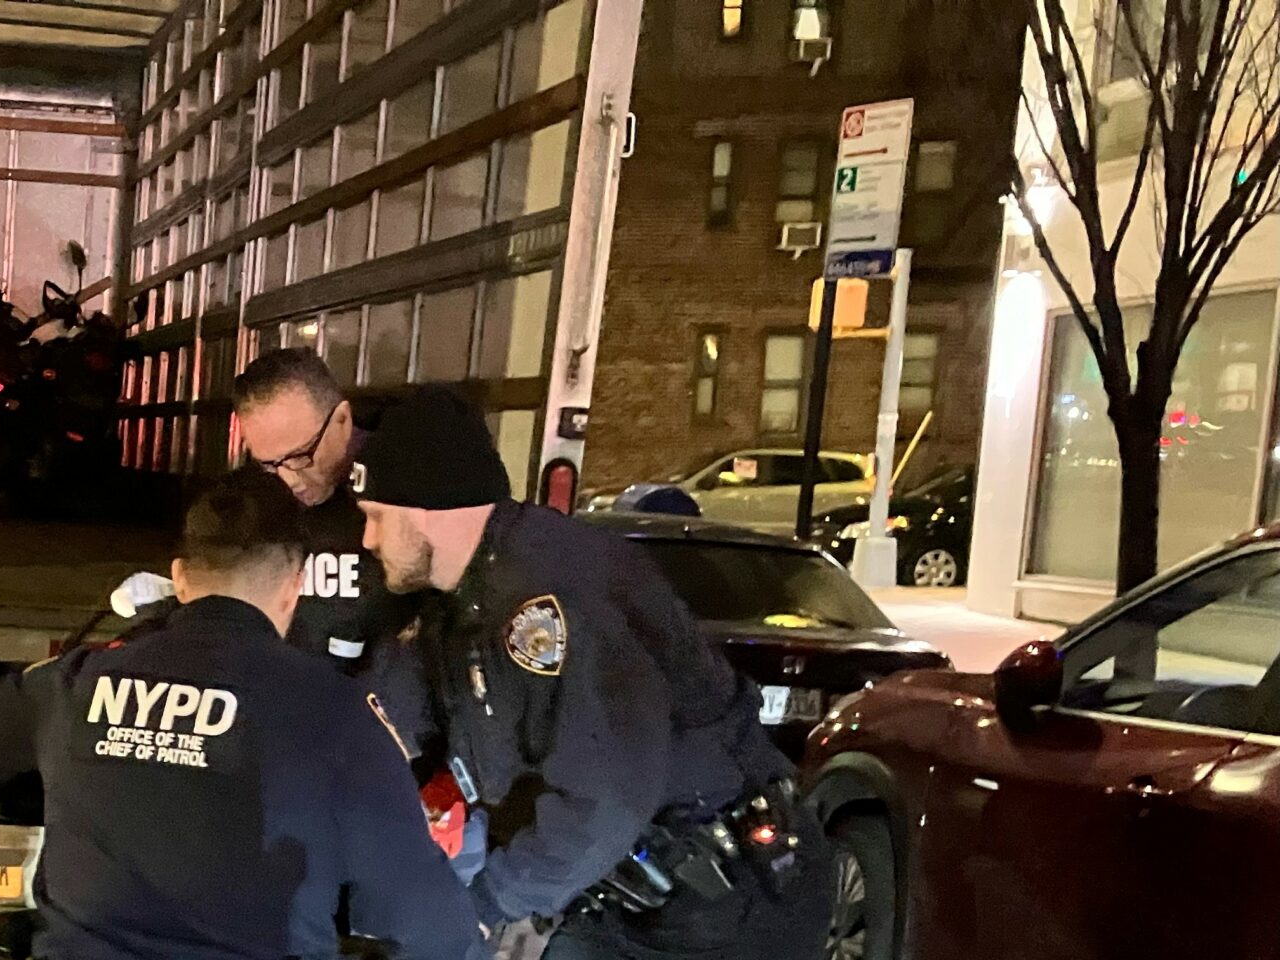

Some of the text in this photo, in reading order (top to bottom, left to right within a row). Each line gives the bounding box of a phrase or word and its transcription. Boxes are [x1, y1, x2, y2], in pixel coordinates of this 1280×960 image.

[840, 168, 854, 193] 2
[298, 552, 360, 598] ICE
[87, 675, 238, 736] NYPD
[106, 726, 205, 751] OFFICE OF THE
[95, 740, 209, 768] CHIEF OF PATROL
